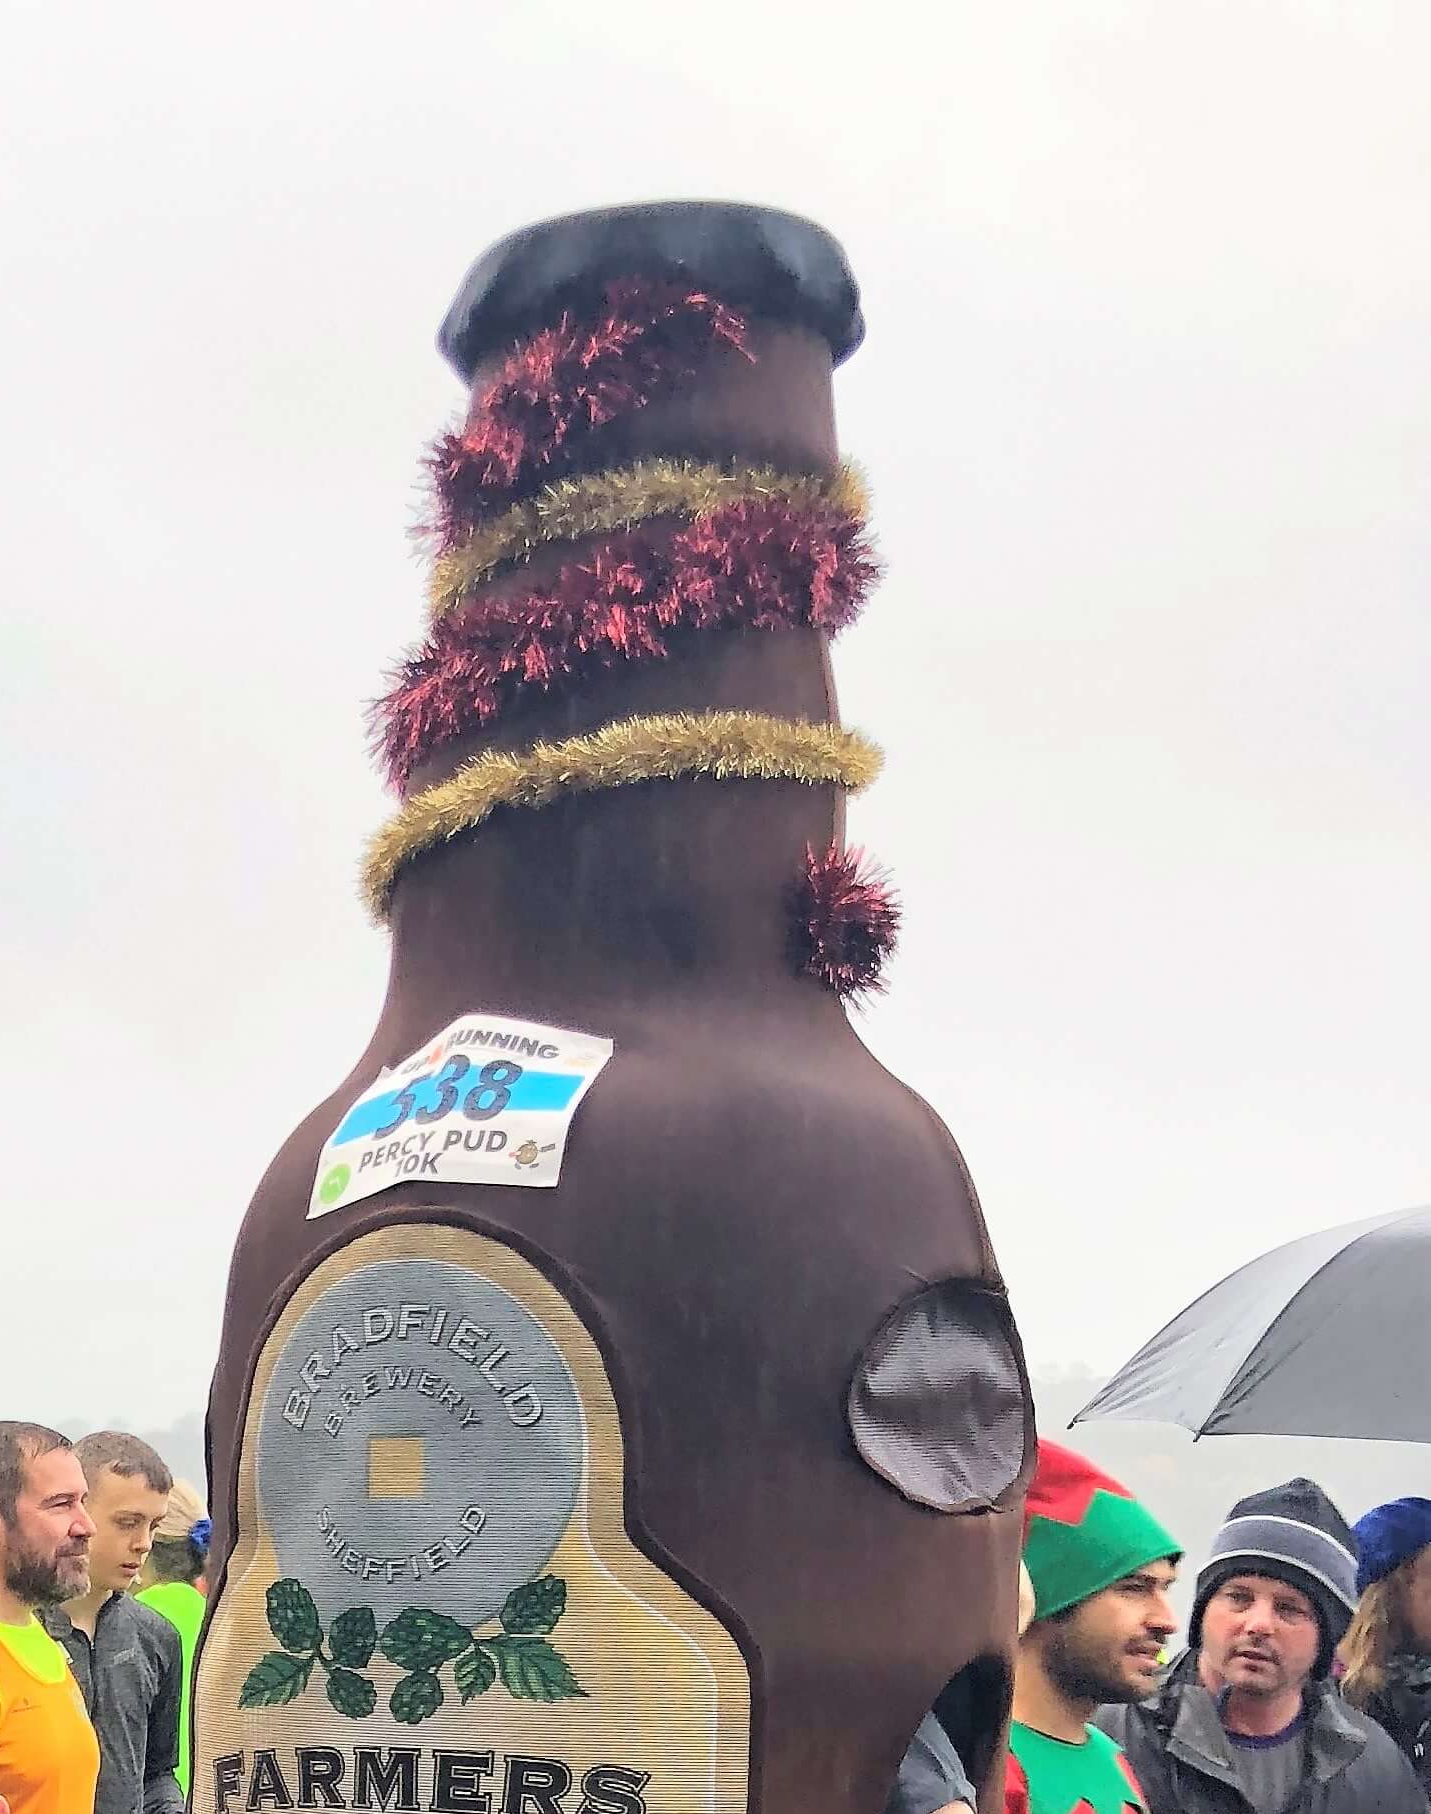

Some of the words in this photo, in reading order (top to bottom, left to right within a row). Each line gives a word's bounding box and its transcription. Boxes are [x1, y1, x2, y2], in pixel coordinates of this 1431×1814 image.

[357, 1131, 435, 1174] PERCY
[443, 1129, 508, 1153] PUD
[394, 1152, 443, 1177] 10K
[282, 1303, 544, 1431] BRADFIELD
[323, 1365, 483, 1438] BREWERY
[317, 1504, 486, 1584] SHEFFIELD
